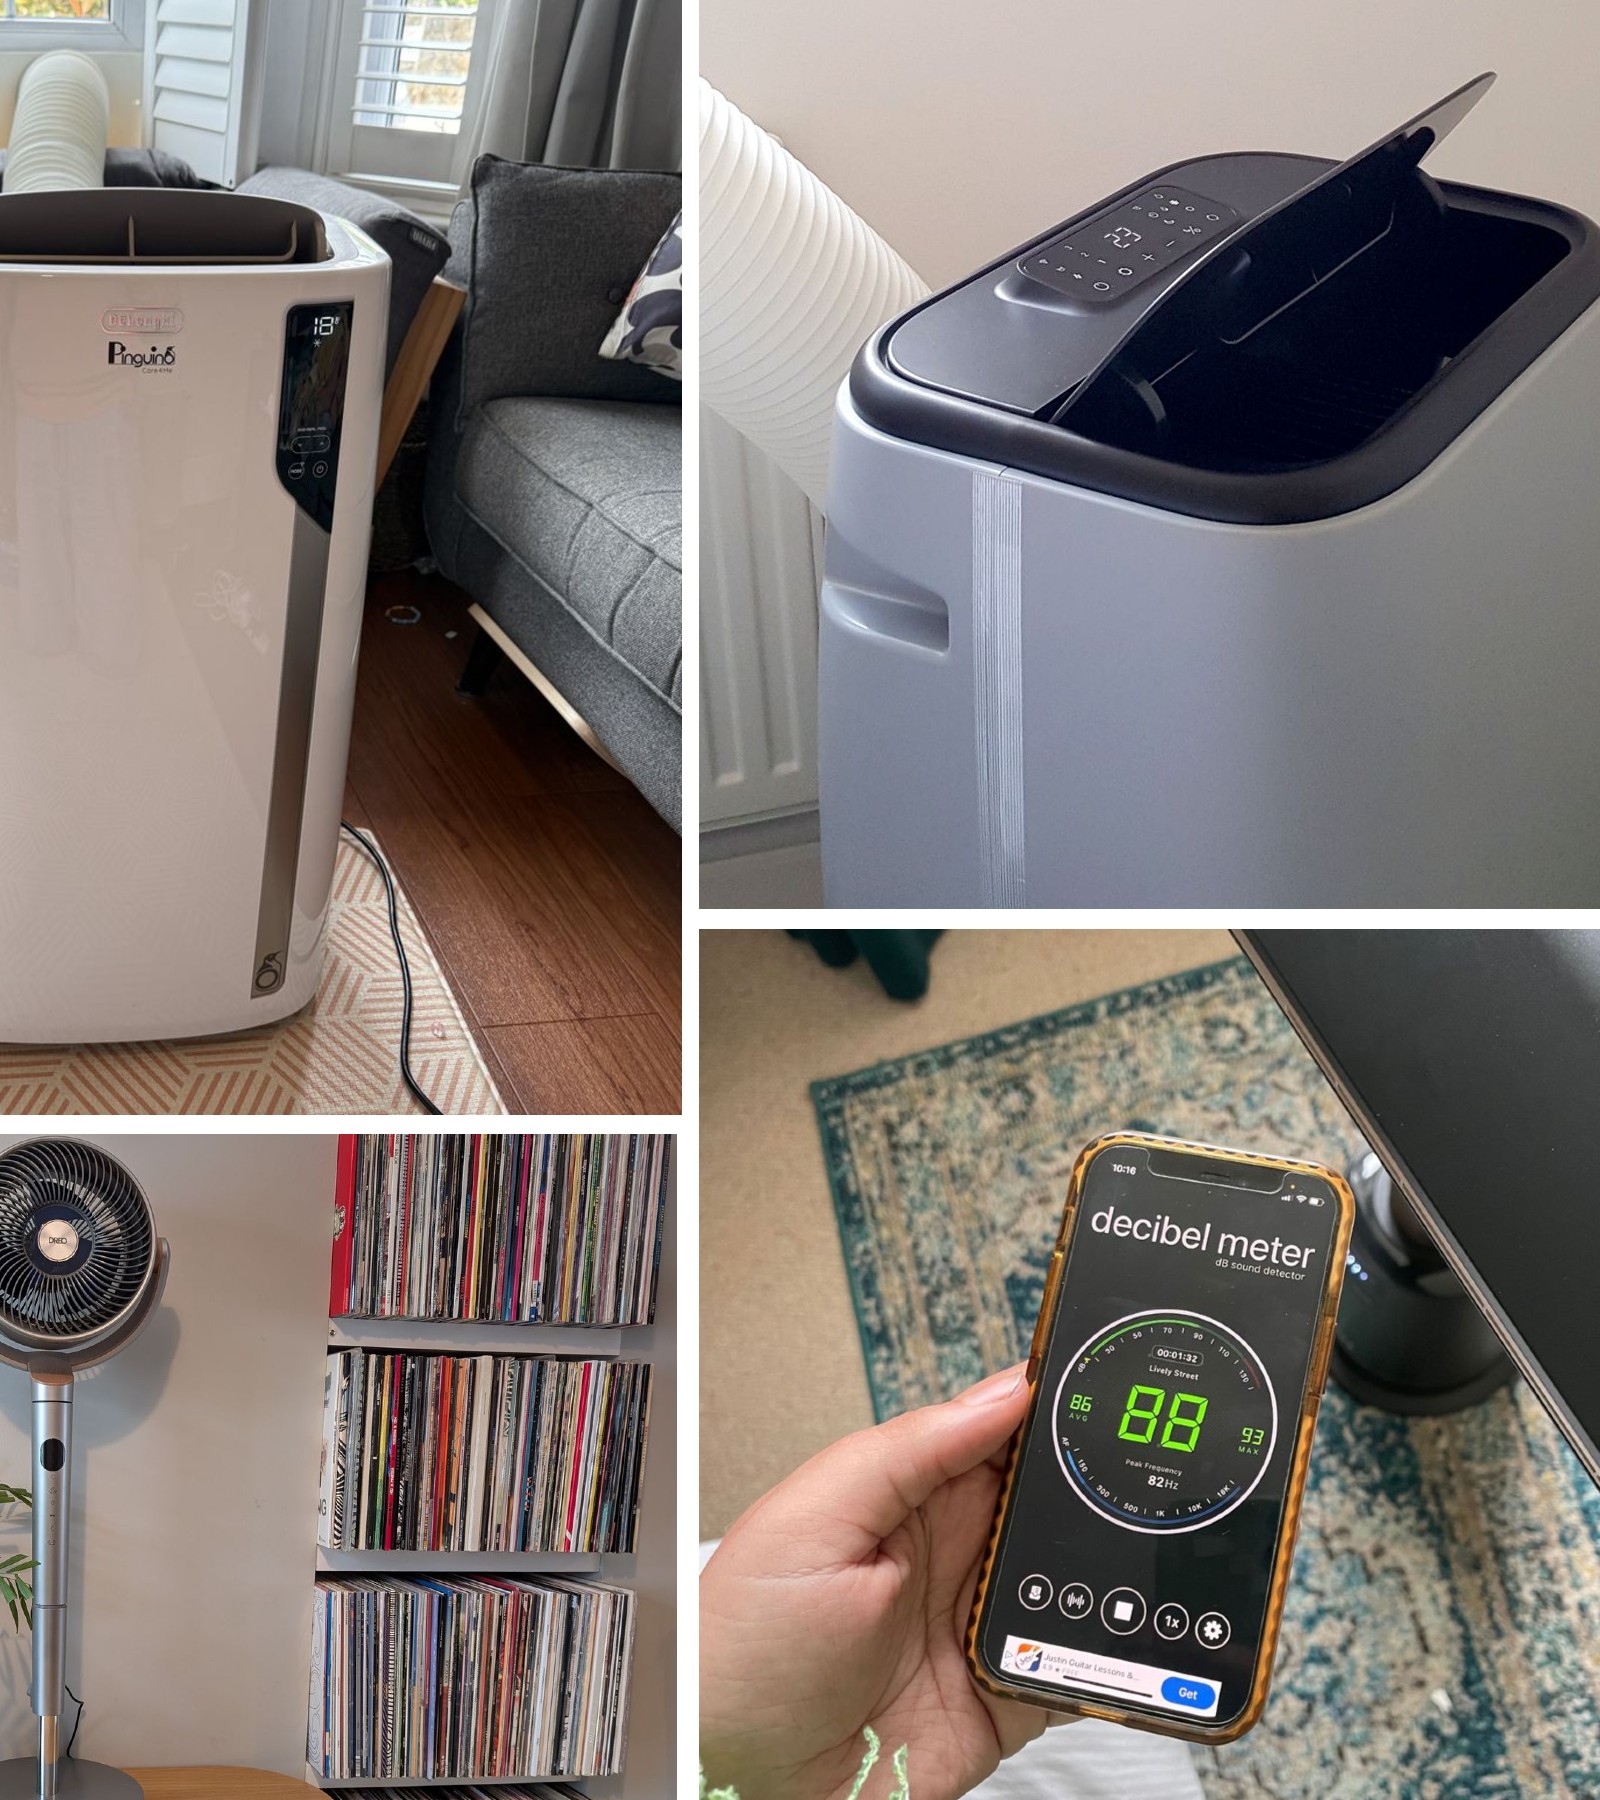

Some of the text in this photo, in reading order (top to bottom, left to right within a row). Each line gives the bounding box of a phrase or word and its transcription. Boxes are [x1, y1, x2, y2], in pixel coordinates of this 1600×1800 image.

[1112, 1163, 1137, 1175] 10:16
[1091, 1206, 1315, 1268] decibel meter
[1215, 1258, 1306, 1281] dB sound detector
[1132, 1331, 1143, 1339] 50
[1193, 1332, 1204, 1341] 90
[1105, 1345, 1115, 1355] 30
[1157, 1348, 1198, 1363] 00:01:32
[1218, 1346, 1230, 1358] 110
[1149, 1364, 1199, 1381] Lively Street
[1238, 1369, 1250, 1383] 130
[1069, 1393, 1093, 1412] 86
[1068, 1412, 1088, 1422] AVG
[1118, 1384, 1209, 1453] 88
[1240, 1427, 1265, 1446] 93
[1238, 1446, 1259, 1455] MAX
[1125, 1459, 1183, 1477] Peak Frequency
[1096, 1484, 1110, 1498] 300
[1123, 1502, 1139, 1513] 500
[1187, 1502, 1202, 1513] 10K
[1164, 1615, 1179, 1629] 1x
[1044, 1654, 1068, 1665] Justin
[1069, 1658, 1093, 1670] Guitar
[1094, 1664, 1125, 1678] Lessons
[1178, 1686, 1198, 1701] Get
